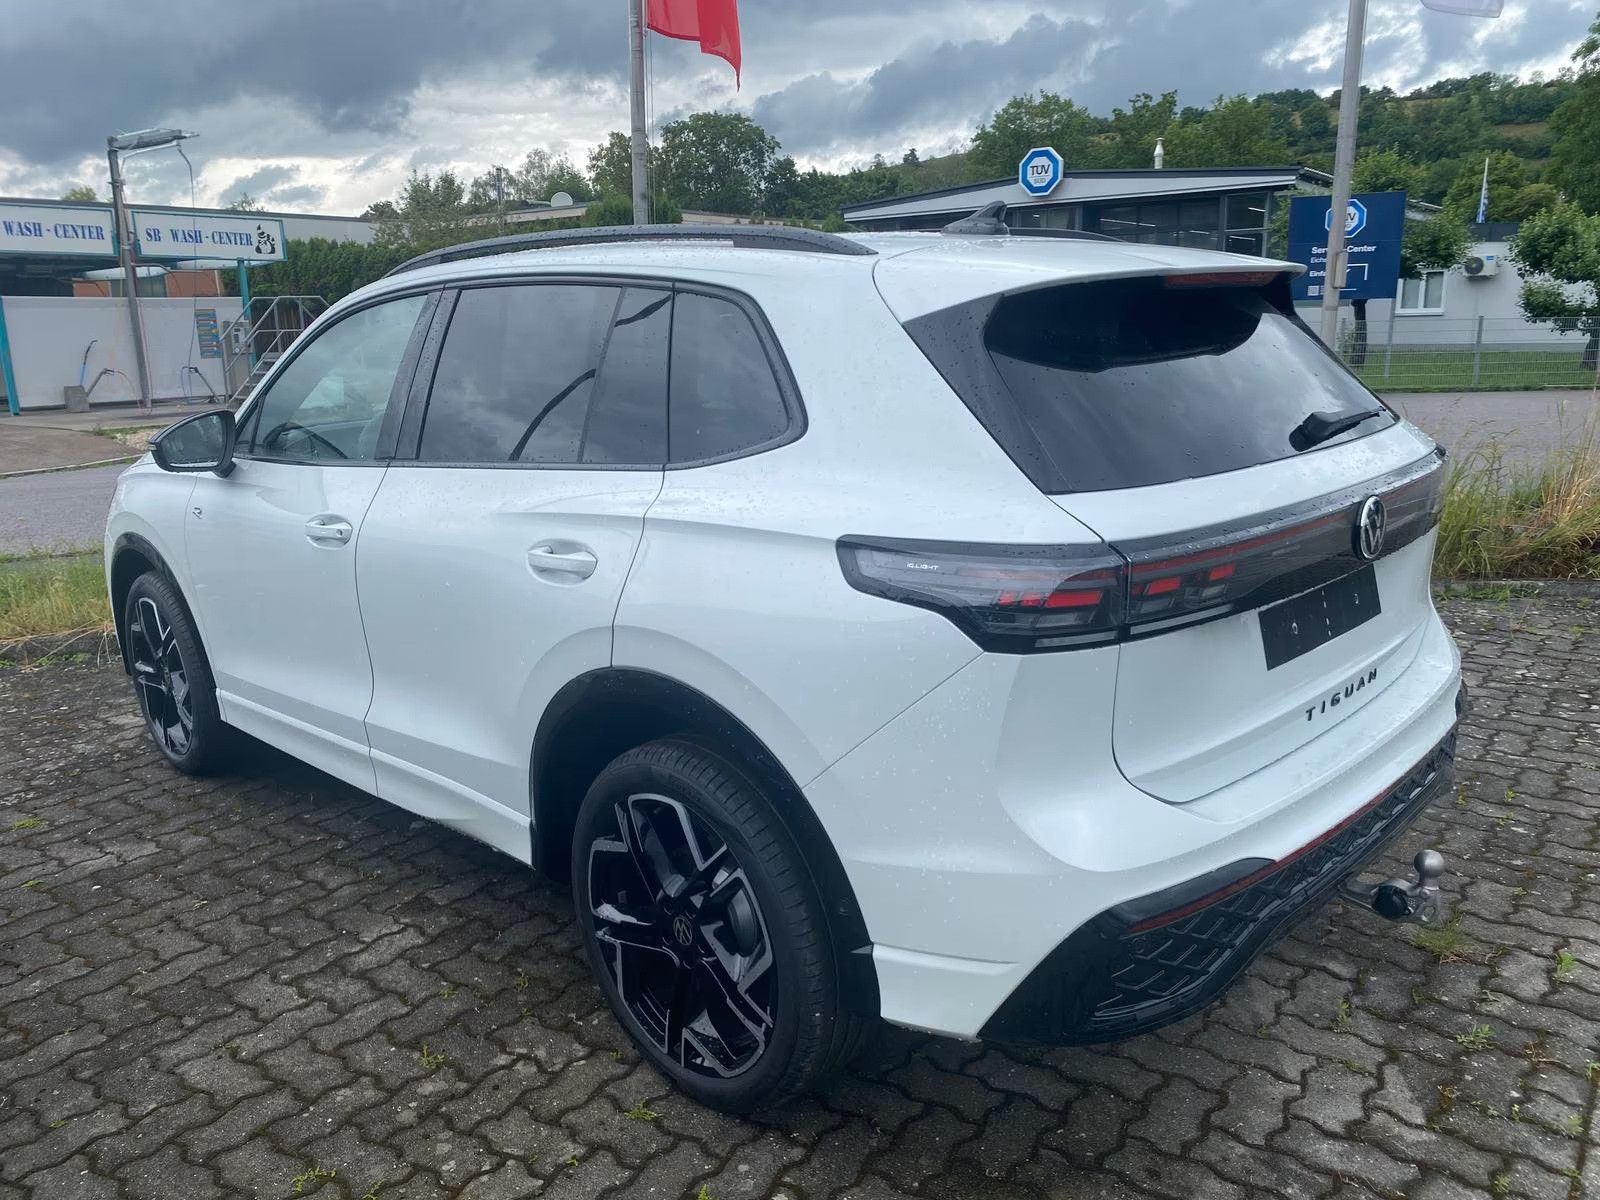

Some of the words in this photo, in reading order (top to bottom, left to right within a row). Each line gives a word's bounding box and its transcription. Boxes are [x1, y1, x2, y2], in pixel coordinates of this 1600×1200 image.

[3, 220, 43, 237] WASH
[53, 223, 105, 240] CENTER
[145, 227, 162, 242] SB
[170, 228, 203, 243] WASH
[211, 230, 253, 246] CENTER
[1305, 667, 1377, 721] TIGUAN
